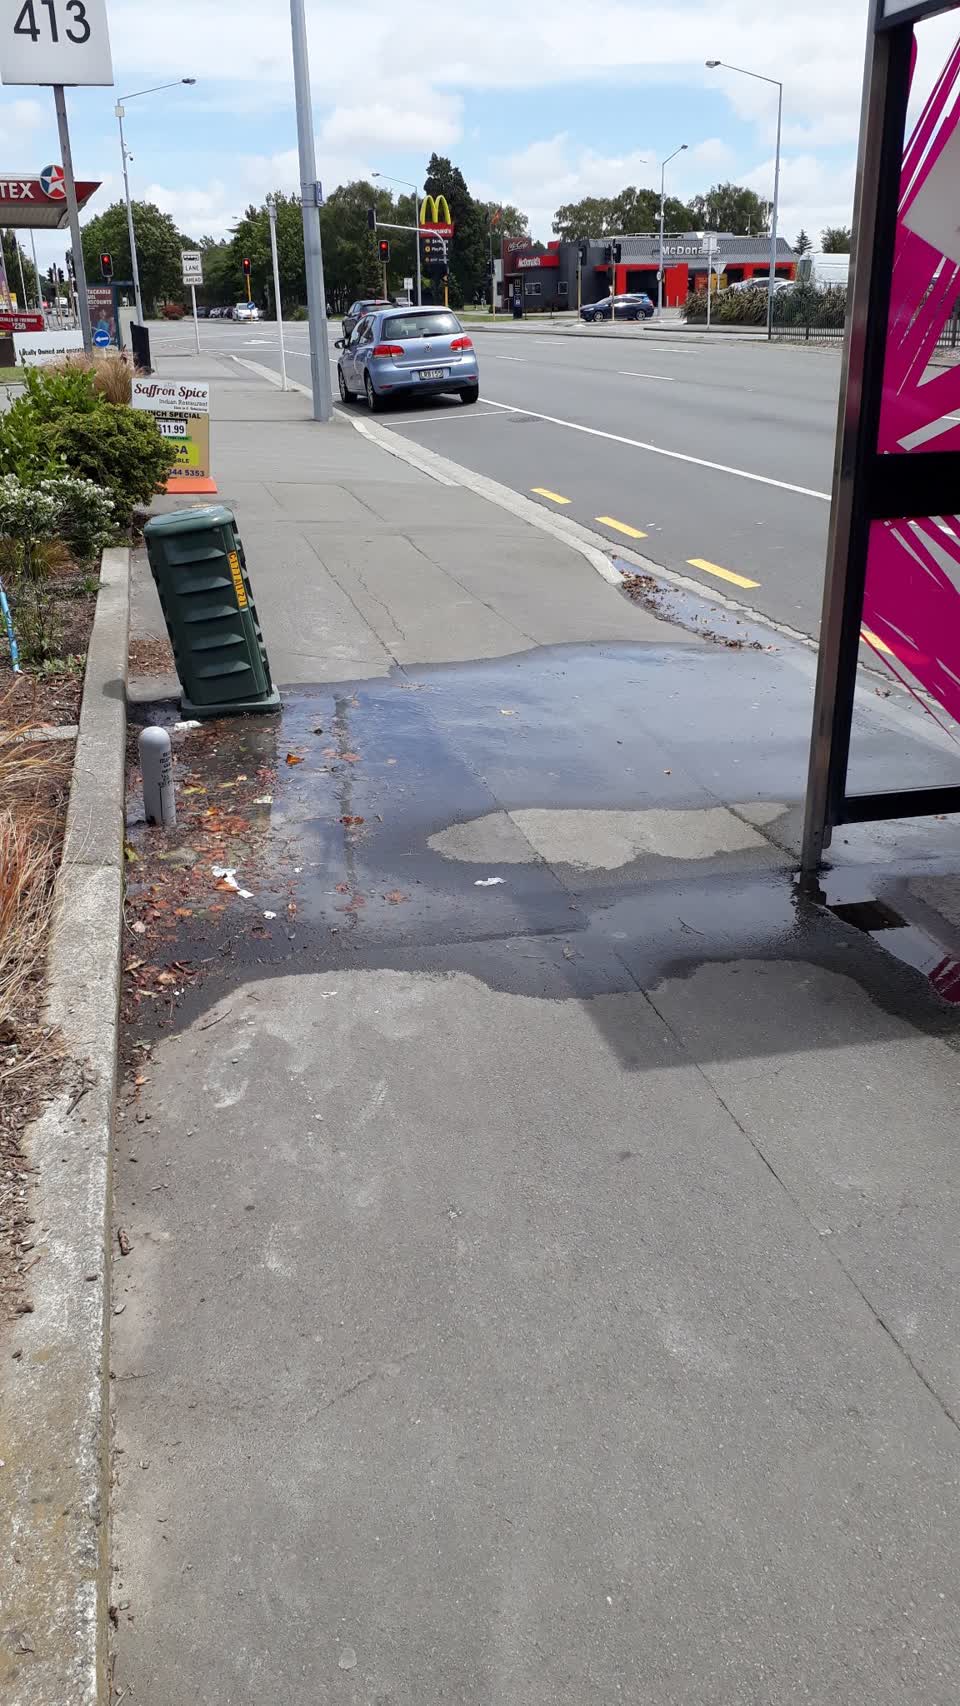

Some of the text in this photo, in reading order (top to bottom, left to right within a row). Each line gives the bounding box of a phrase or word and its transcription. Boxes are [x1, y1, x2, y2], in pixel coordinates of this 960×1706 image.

[13, 0, 91, 44] 413
[0, 182, 35, 199] TEX
[662, 246, 721, 255] McDonas
[134, 383, 207, 399] Saffron Spice
[174, 445, 188, 455] SA
